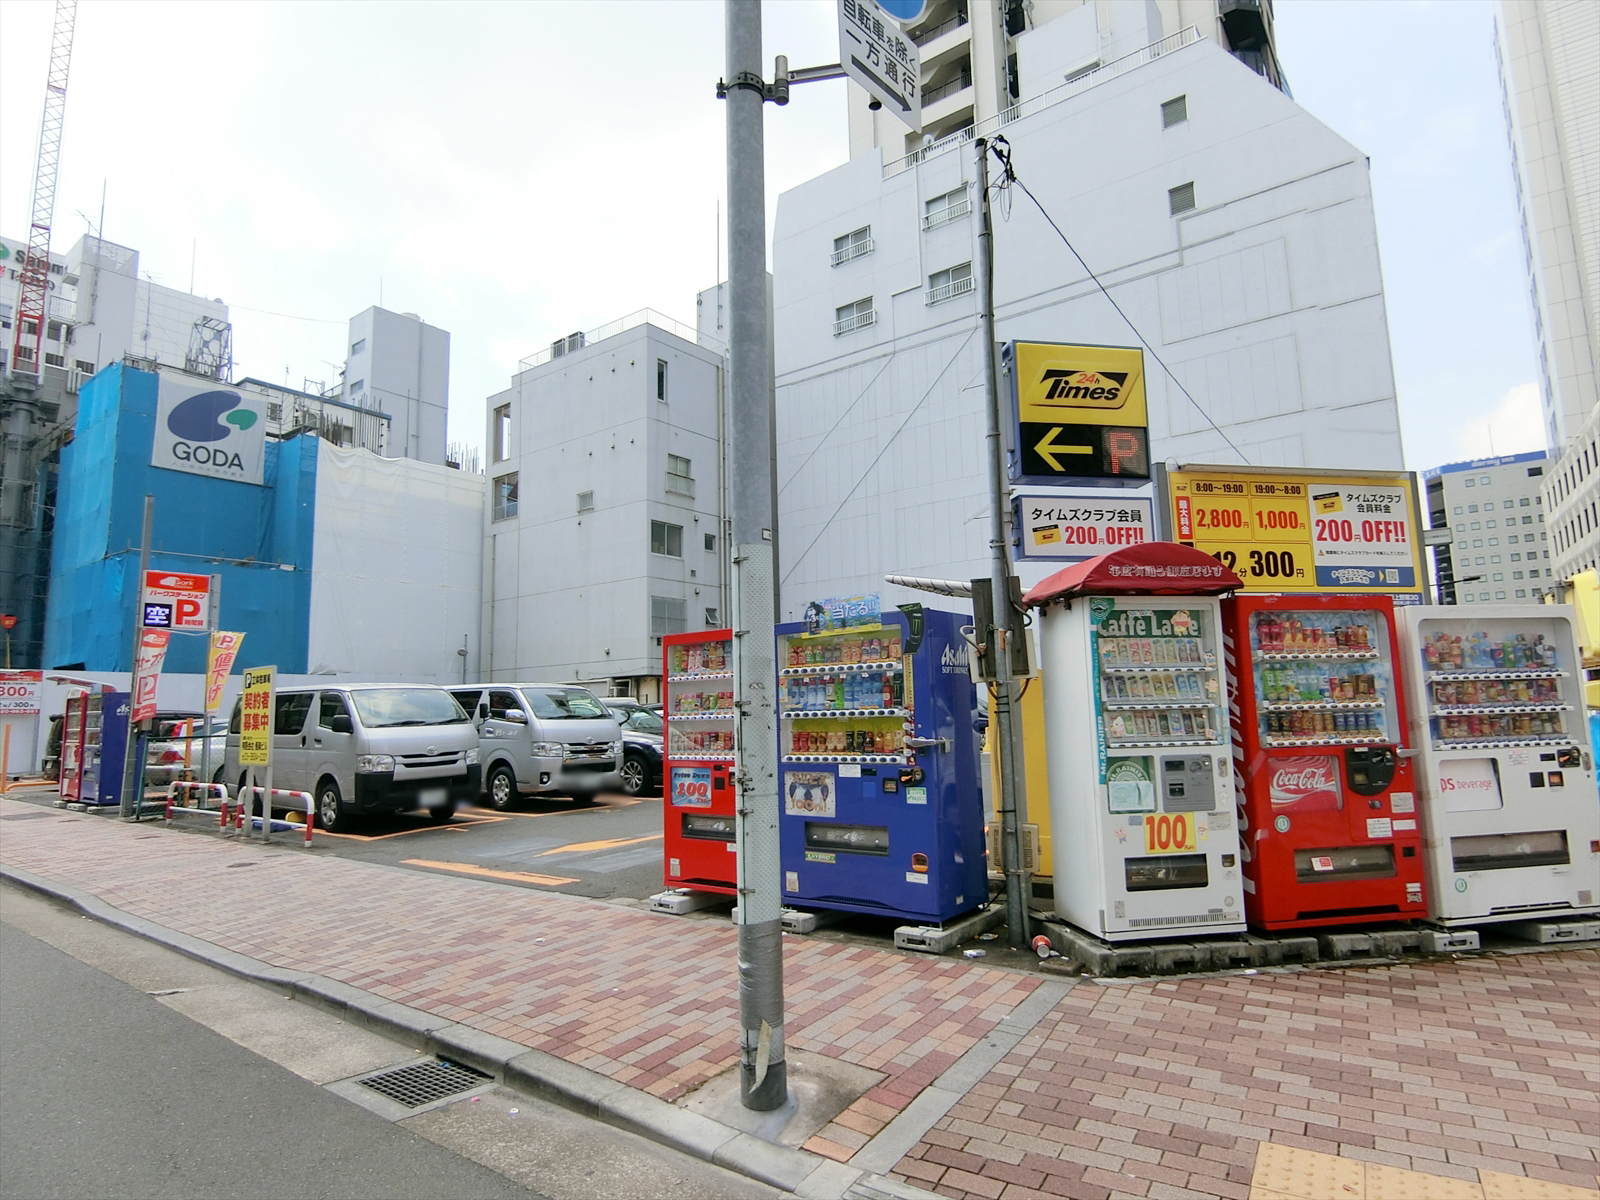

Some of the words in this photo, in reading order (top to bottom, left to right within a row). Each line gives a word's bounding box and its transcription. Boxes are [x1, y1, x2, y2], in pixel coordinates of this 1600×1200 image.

[843, 0, 917, 73] 自転車を除く
[845, 28, 916, 98] 一方通行
[1044, 377, 1121, 401] Times
[172, 441, 244, 472] GODA
[1108, 431, 1140, 474] P
[1346, 493, 1402, 503] タイムズクラブ
[1356, 503, 1392, 514] 会員料金
[1031, 507, 1143, 523] タイムズクラブ会員
[1178, 499, 1191, 535] 最大料金
[1196, 508, 1250, 529] 2,800円
[1255, 510, 1306, 530] 1,000円
[1249, 550, 1305, 578] 300円
[149, 589, 206, 600] パークステーション
[145, 606, 170, 625] 空
[175, 599, 201, 625] P
[1151, 614, 1199, 636] Lae
[220, 635, 234, 646] P
[941, 643, 968, 666] Asahi
[207, 652, 234, 704] 値下げ
[244, 691, 270, 710] 契約者
[243, 711, 269, 731] 募集中
[676, 781, 708, 797] 100
[1456, 779, 1493, 791] beverage
[1145, 814, 1187, 851] 100
